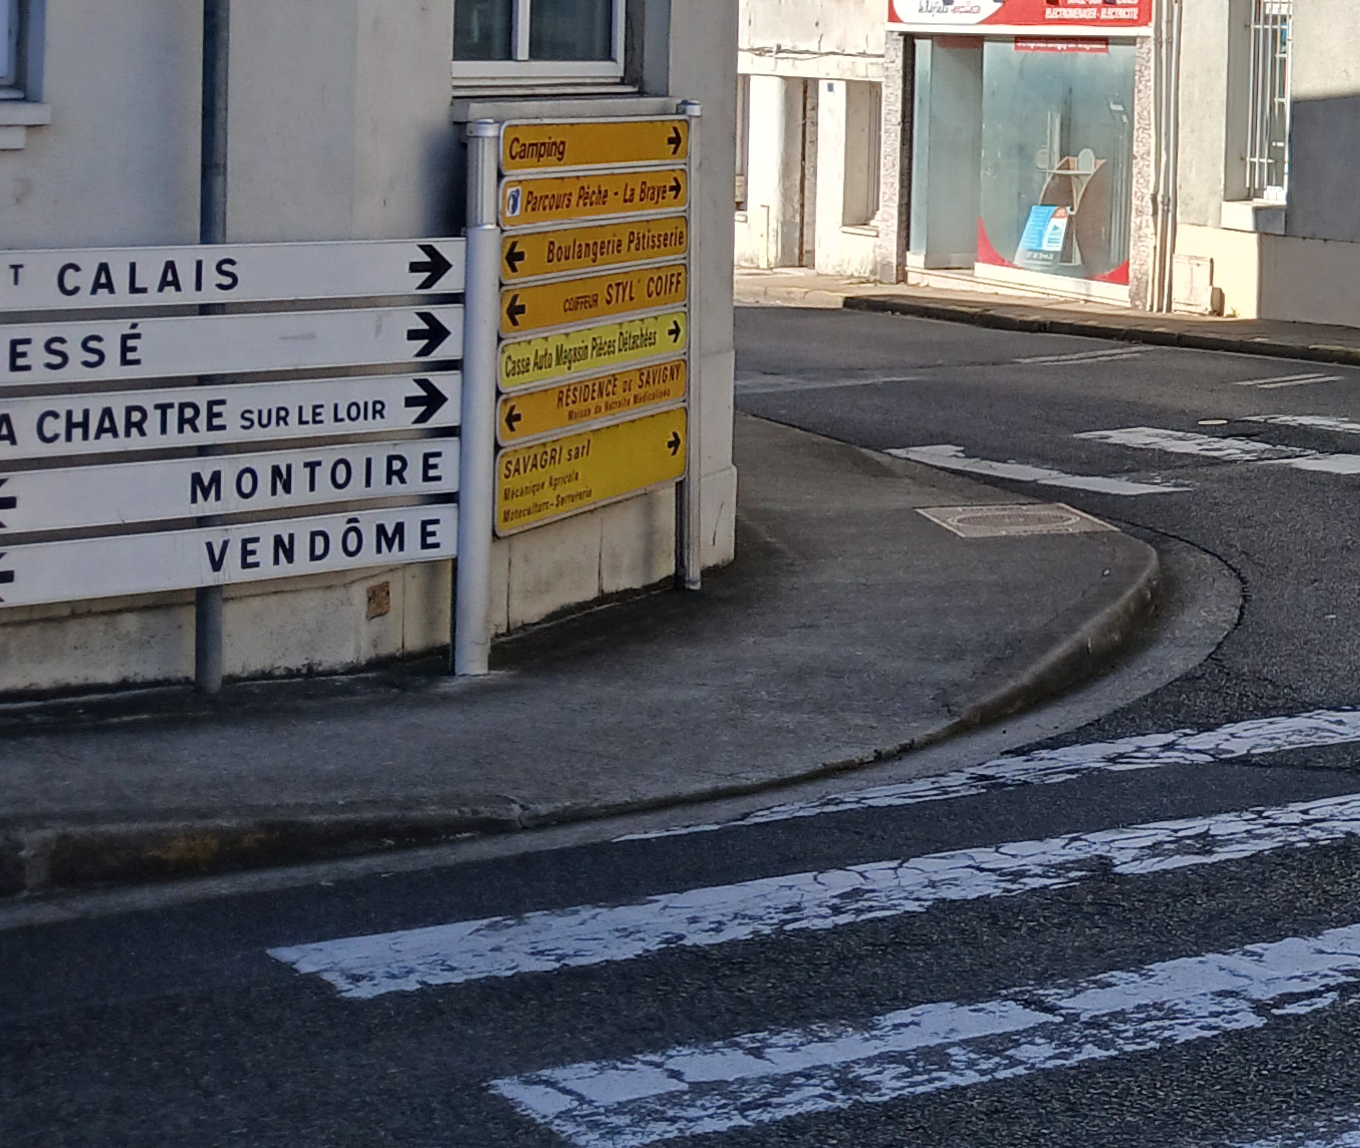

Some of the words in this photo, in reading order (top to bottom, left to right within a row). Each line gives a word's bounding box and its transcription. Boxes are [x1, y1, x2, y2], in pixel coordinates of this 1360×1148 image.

[509, 136, 566, 162] Camping
[525, 190, 572, 213] Parcours
[576, 185, 609, 208] Pêche
[623, 183, 634, 203] La
[639, 181, 667, 204] Braye
[547, 233, 622, 263] Boulangerie
[627, 226, 684, 253] Pâtisserie
[57, 257, 239, 296] CALAIS
[647, 272, 682, 298] COIFF
[8, 323, 142, 372] ESSÉ
[505, 355, 530, 378] Casse
[533, 348, 553, 371] Auto
[555, 340, 589, 371] Magasin
[557, 374, 618, 409] RÉSIDENCE
[638, 363, 682, 389] SAVIGNY
[36, 399, 227, 444] CHARTRE
[240, 407, 290, 430] SUR
[298, 404, 324, 425] LE
[333, 400, 386, 423] LOIR
[190, 452, 442, 504] MONTOIRE
[504, 446, 562, 479] SAVAGRI
[567, 439, 590, 462] sarl
[205, 518, 441, 572] VENDÔME
